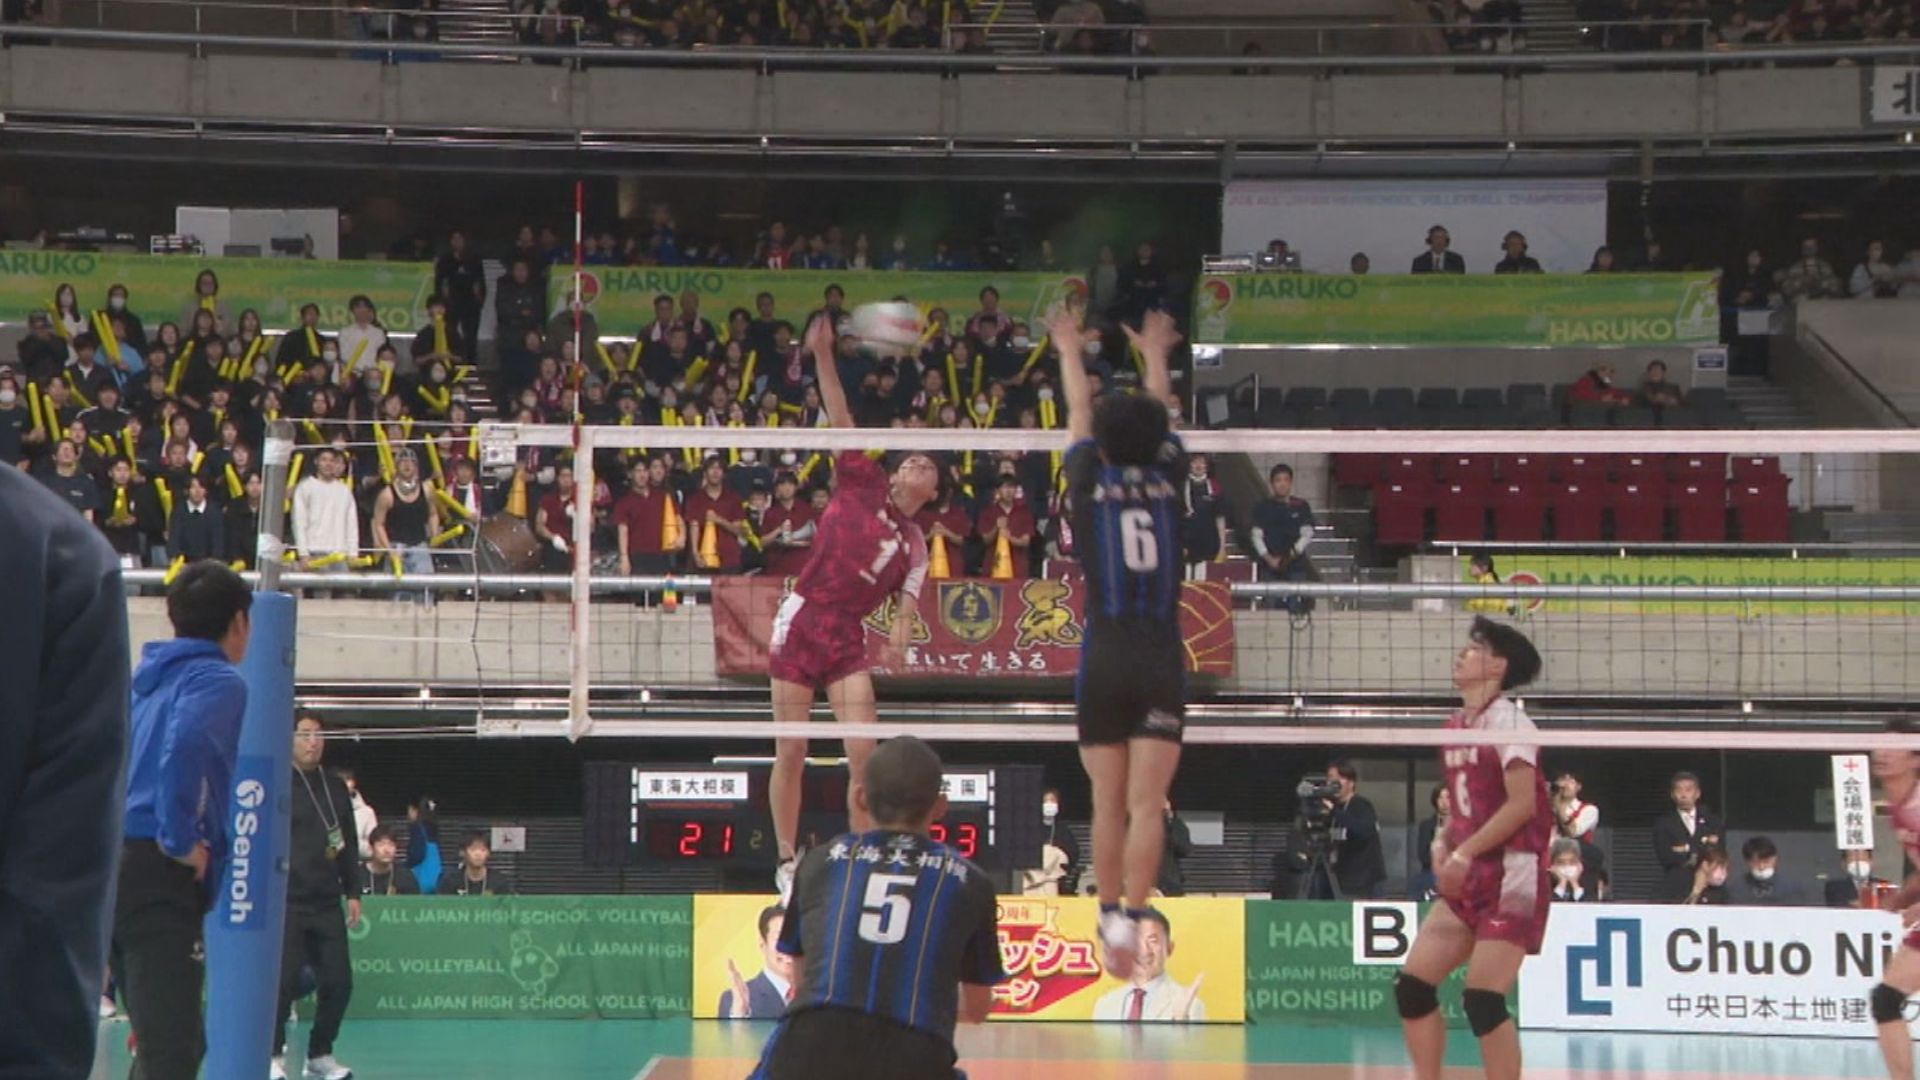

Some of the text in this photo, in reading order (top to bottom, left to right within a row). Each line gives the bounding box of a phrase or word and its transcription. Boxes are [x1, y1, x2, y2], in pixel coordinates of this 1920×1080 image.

[604, 270, 723, 293] HARUKO
[1235, 278, 1358, 300] HARUKO
[1550, 318, 1673, 342] HARUKO
[1120, 507, 1158, 572] 6
[870, 539, 899, 574] 1
[649, 778, 736, 795] 東海大相模
[679, 822, 732, 856] 21
[230, 812, 258, 923] Senoh
[379, 909, 410, 923] ALL
[414, 909, 470, 923] JAPAN
[474, 908, 517, 923] HIGH
[519, 909, 592, 925] SCHOOL
[857, 872, 918, 944] 5
[1363, 906, 1409, 959] B
[556, 943, 585, 957] ALL
[589, 942, 644, 957] JAPAN
[1000, 934, 1097, 973] ッシュ
[1665, 926, 1813, 977] Chuo
[400, 959, 505, 973] VOLLEYBALL
[1260, 966, 1316, 981] JAPAN
[1320, 966, 1363, 981] HIGH
[376, 996, 407, 1009] ALL
[411, 995, 467, 1010] JAPAN
[472, 995, 513, 1010] HIGH
[519, 995, 591, 1010] SCHOOL
[992, 981, 1038, 1004] ーン
[1666, 993, 1920, 1025] 中央日本土地建
